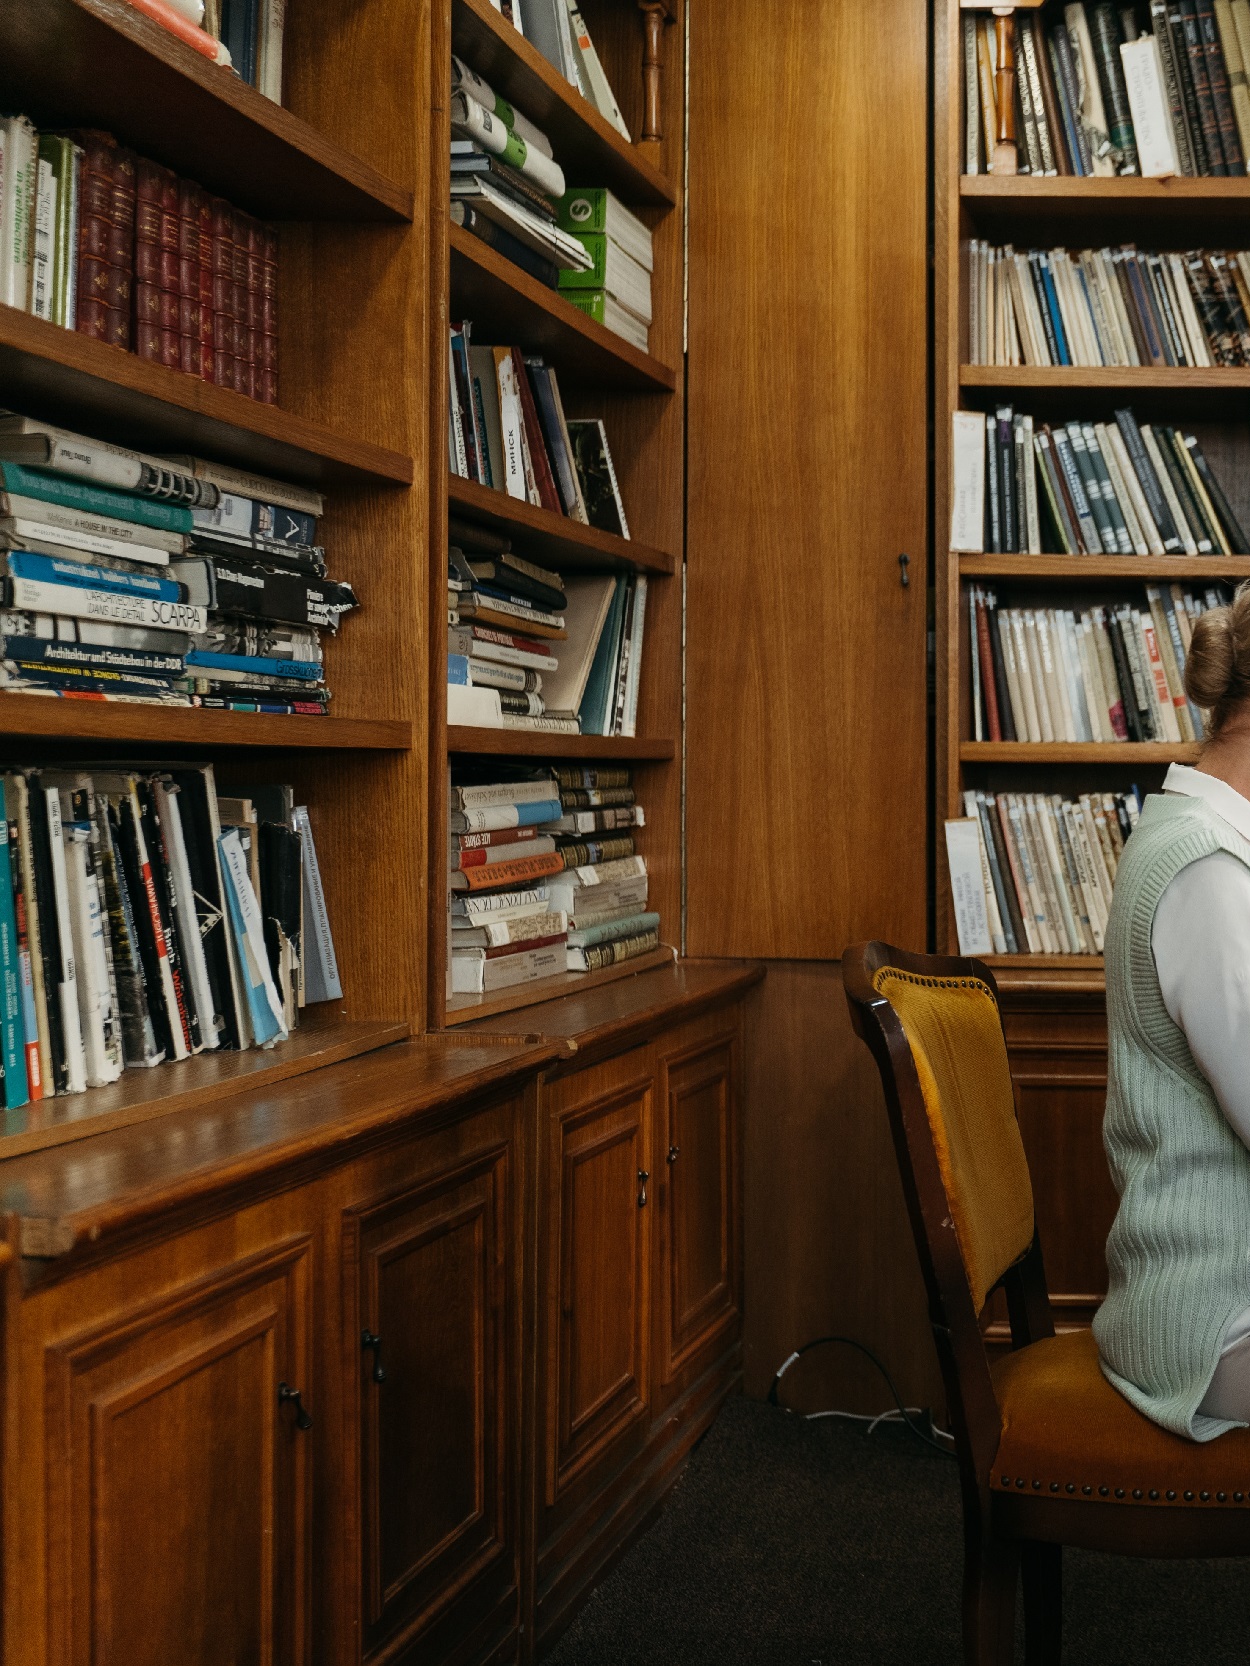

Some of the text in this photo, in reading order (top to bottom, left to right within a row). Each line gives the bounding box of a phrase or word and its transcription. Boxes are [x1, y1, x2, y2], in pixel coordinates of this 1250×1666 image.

[13, 185, 24, 264] architecture
[507, 429, 517, 476] МИНСК
[80, 519, 101, 531] HOUSE
[108, 525, 121, 537] THE
[120, 527, 134, 539] CITY
[87, 603, 110, 617] DANS
[151, 600, 201, 630] SCARPA
[45, 644, 90, 662] Architektur
[91, 651, 106, 663] und
[105, 651, 144, 667] Städtebau
[152, 657, 166, 669] der
[165, 657, 182, 671] DDR
[303, 825, 317, 867] УПРАВЛЕНИЕ
[146, 876, 164, 945] JUGOSŁAWIA
[172, 969, 192, 1052] Wohnheime
